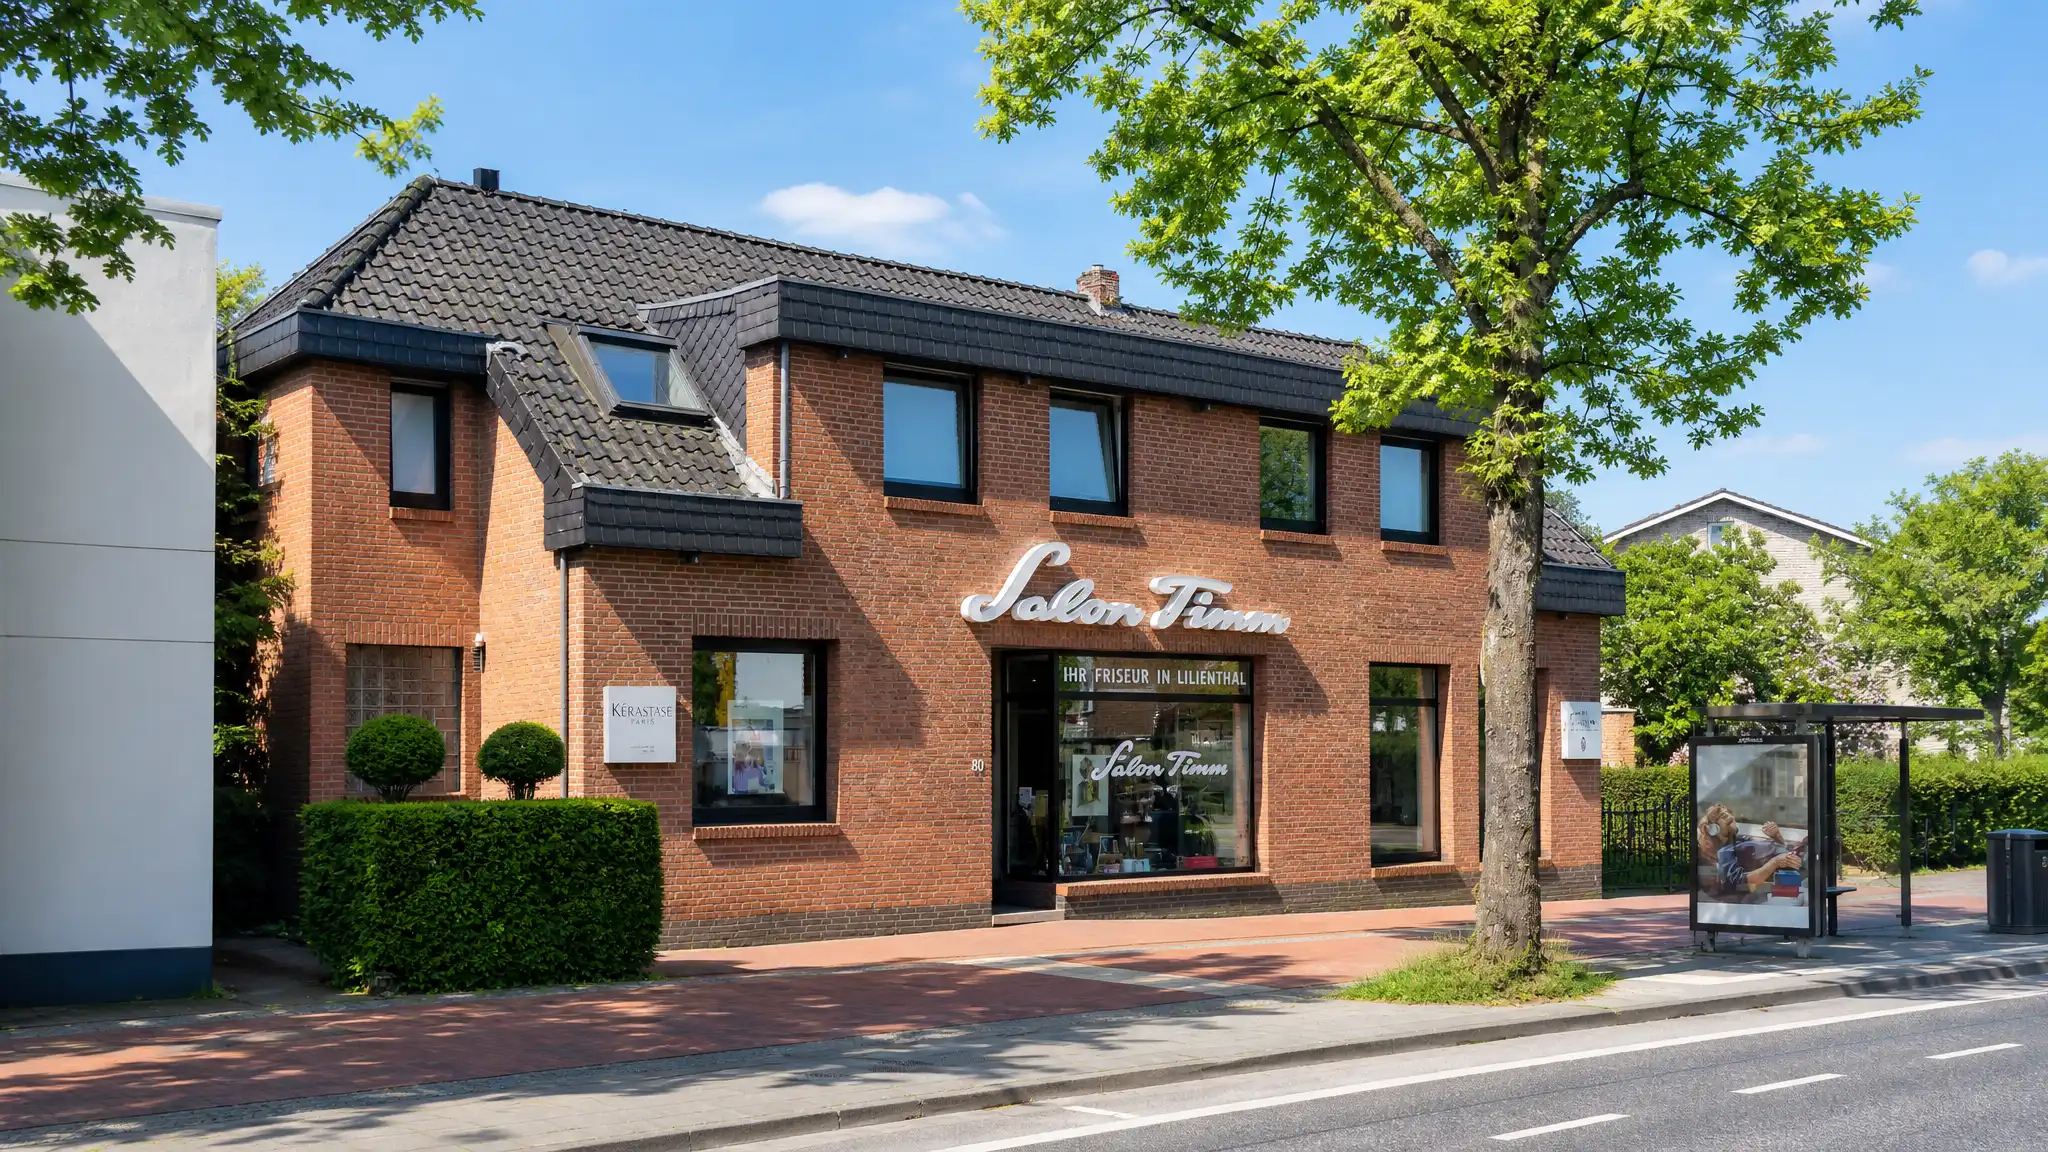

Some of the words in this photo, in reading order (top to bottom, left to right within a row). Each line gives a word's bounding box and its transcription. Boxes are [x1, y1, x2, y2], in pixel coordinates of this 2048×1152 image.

[960, 541, 1145, 627] Salon
[1149, 575, 1291, 635] Timm
[1063, 666, 1087, 683] IHR
[1095, 667, 1149, 684] FRISEUR
[1157, 669, 1170, 685] IN
[1177, 670, 1247, 686] LILIENTHAL
[612, 702, 673, 718] KÉRASTASE
[971, 759, 984, 772] 80
[1091, 740, 1165, 780] Salon
[1166, 750, 1228, 777] Timm
